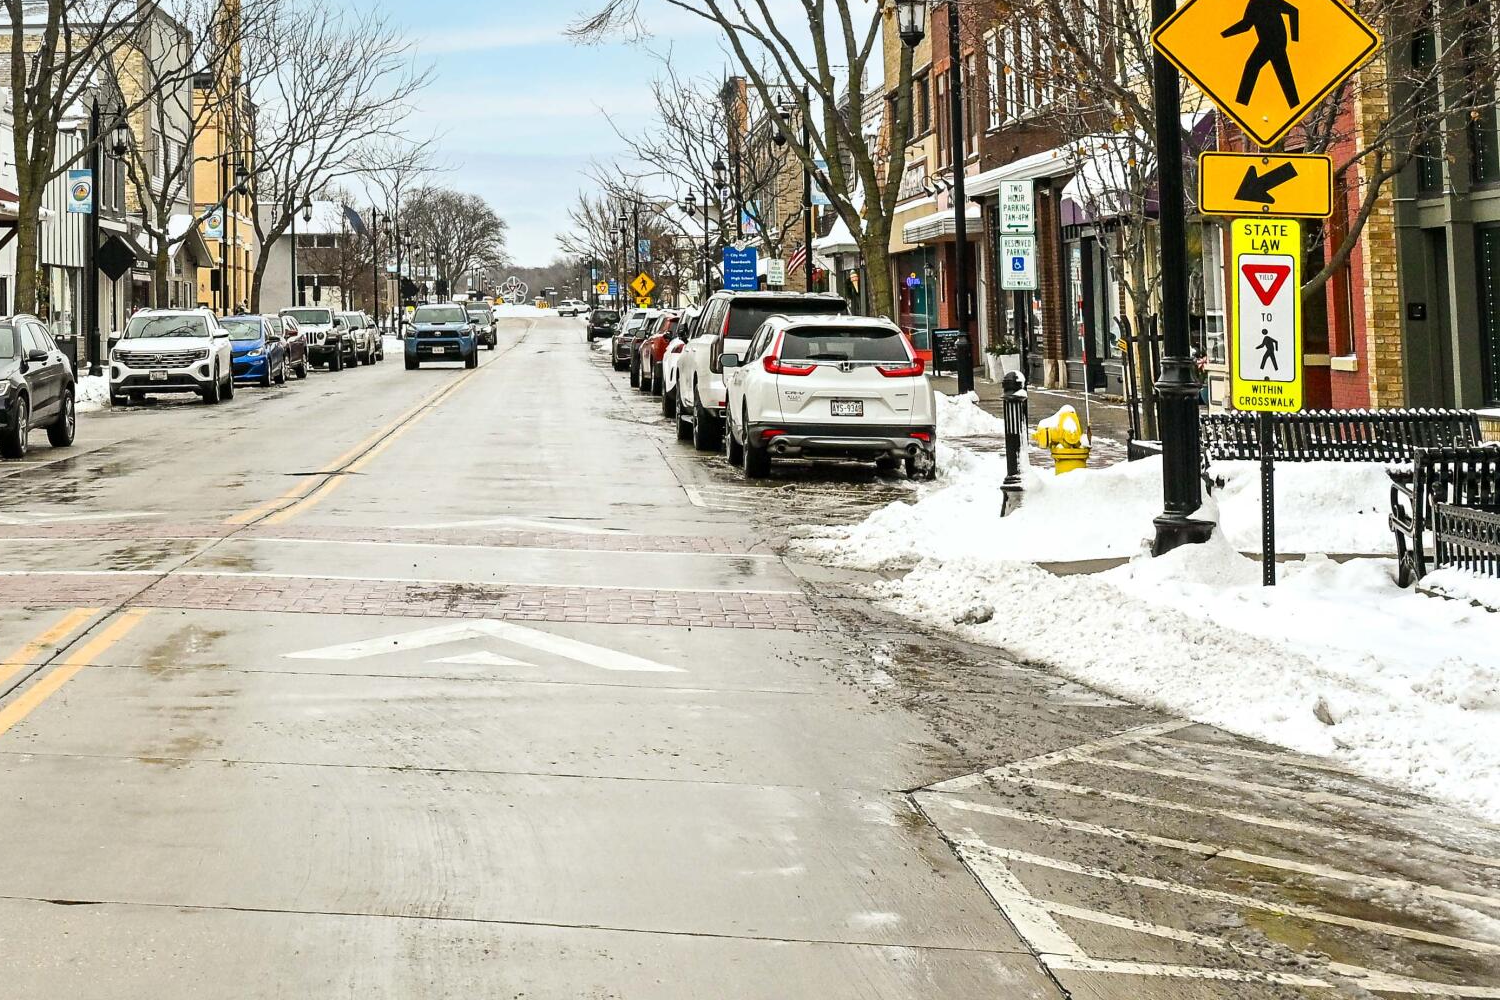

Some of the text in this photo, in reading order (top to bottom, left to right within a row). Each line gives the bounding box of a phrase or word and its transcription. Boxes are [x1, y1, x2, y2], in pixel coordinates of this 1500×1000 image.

[1010, 184, 1023, 192] TWO
[1007, 194, 1025, 202] HOUR
[1003, 204, 1030, 212] PARKING
[1005, 213, 1029, 221] 7AM-4PM
[1244, 224, 1288, 236] STATE
[1004, 239, 1031, 247] RESERVED
[1251, 239, 1280, 251] LAW
[1006, 248, 1030, 256] PARKING
[1261, 312, 1273, 322] TO
[1251, 384, 1283, 395] WITHIN
[1239, 396, 1295, 408] CROSSWALK
